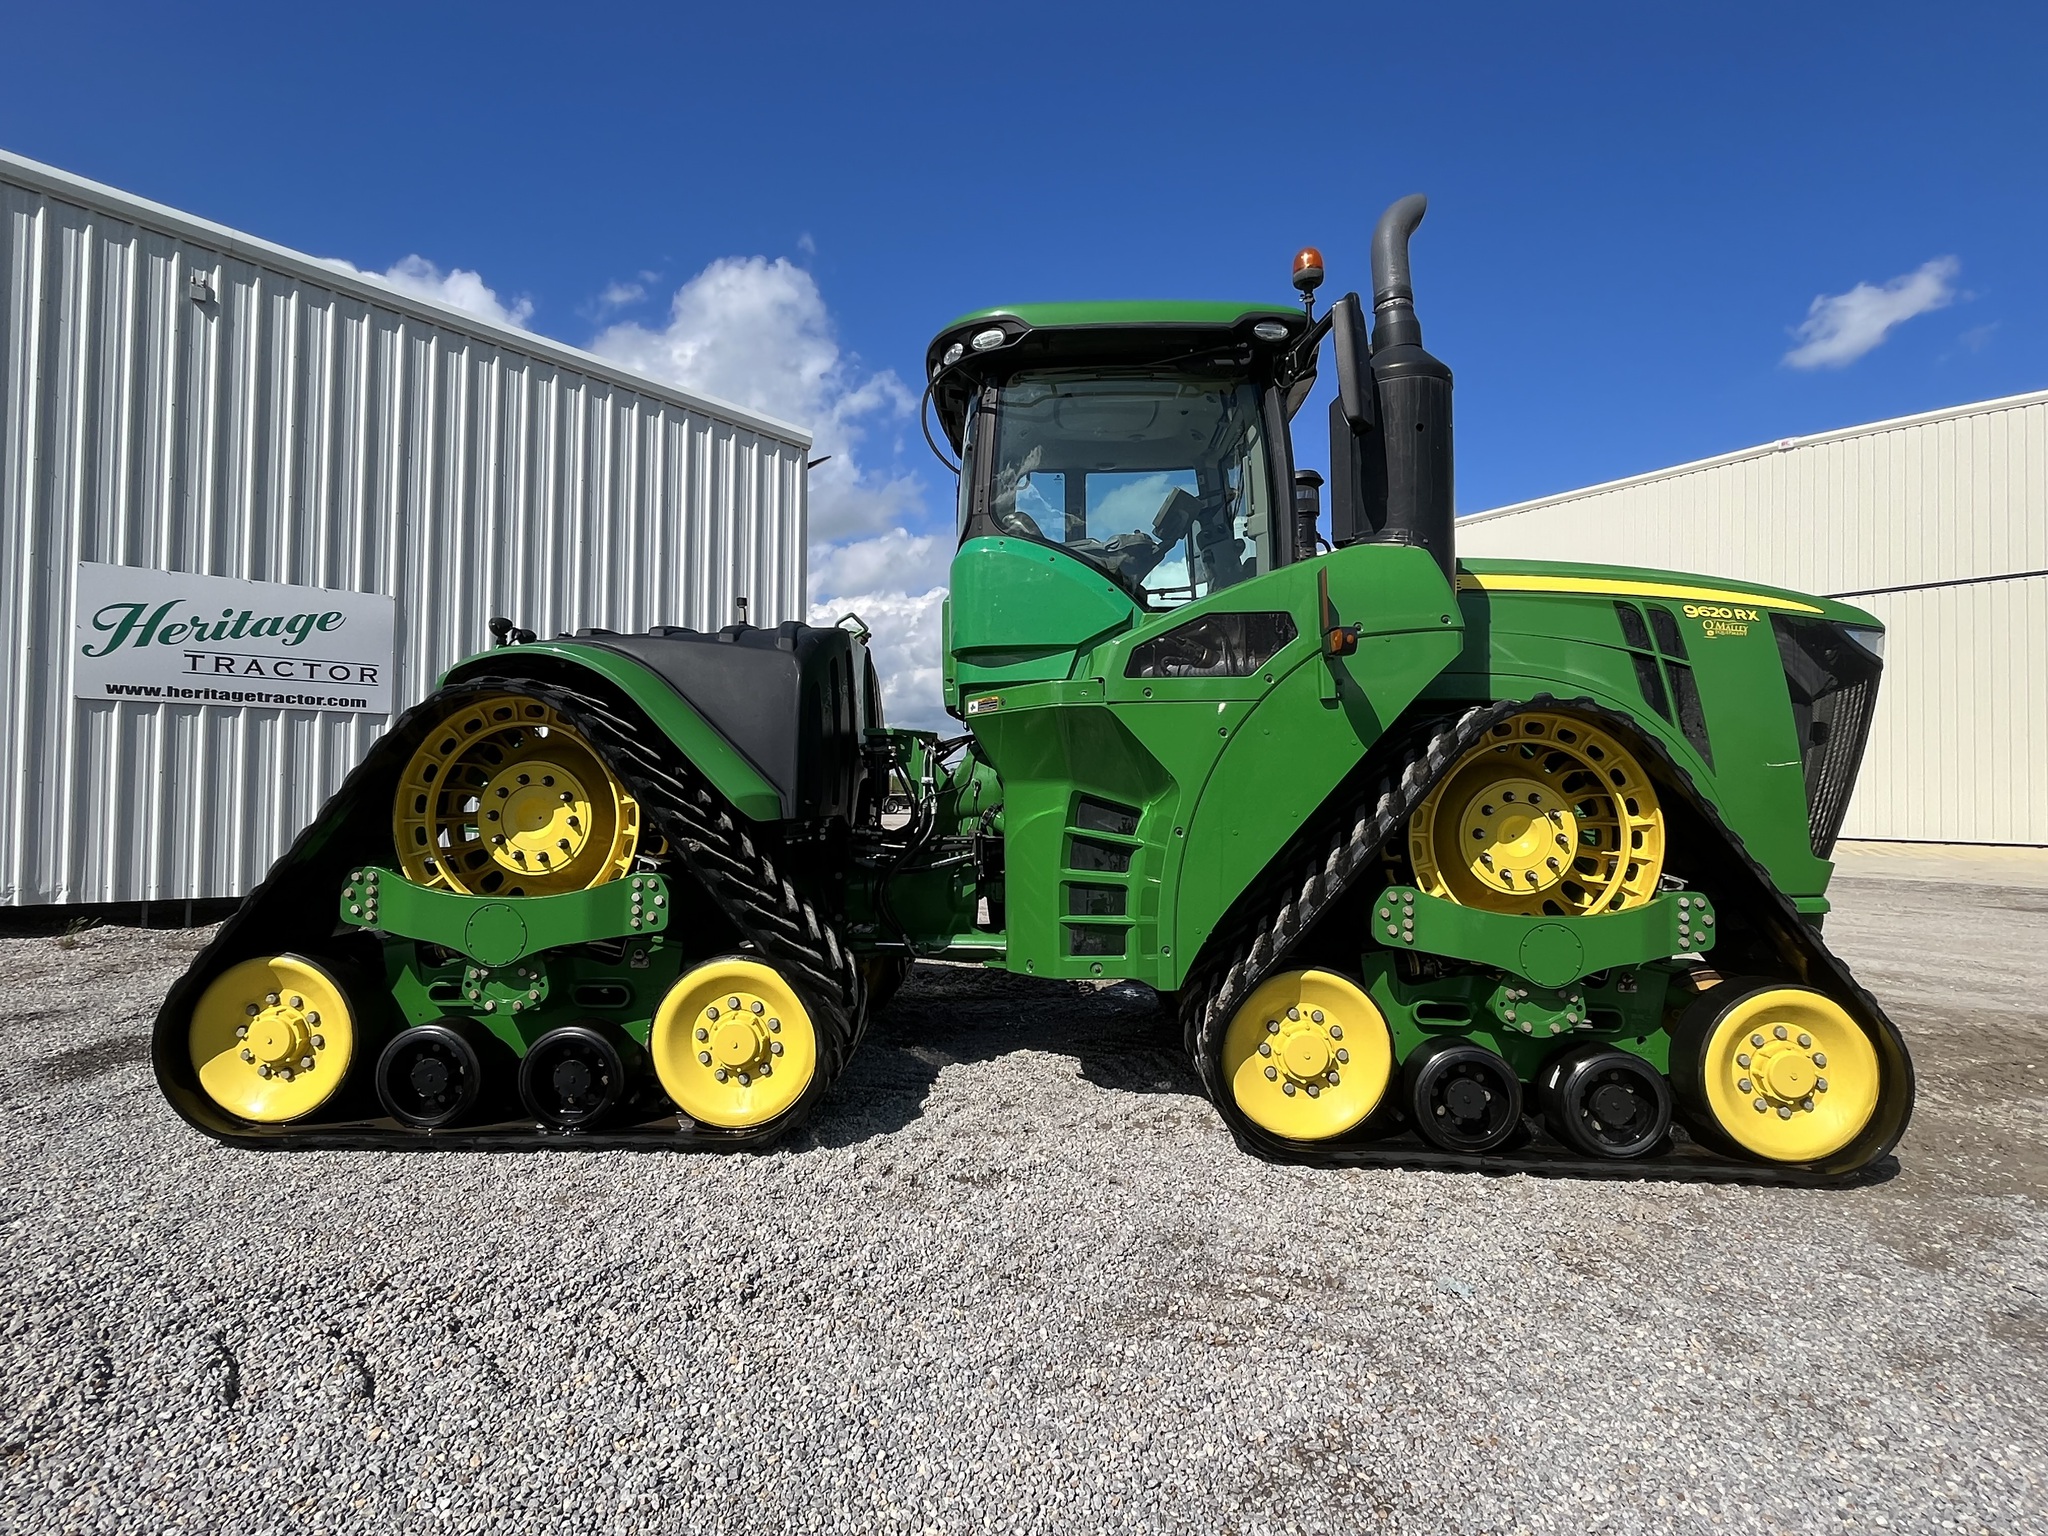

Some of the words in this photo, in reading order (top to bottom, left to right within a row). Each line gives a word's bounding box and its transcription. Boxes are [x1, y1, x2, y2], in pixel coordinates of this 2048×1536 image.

[1682, 604, 1733, 619] 9620
[1733, 608, 1760, 622] RX
[81, 599, 346, 658] Heritage
[184, 653, 379, 684] TRACTOR
[106, 683, 367, 708] www.heritagetractor.com
